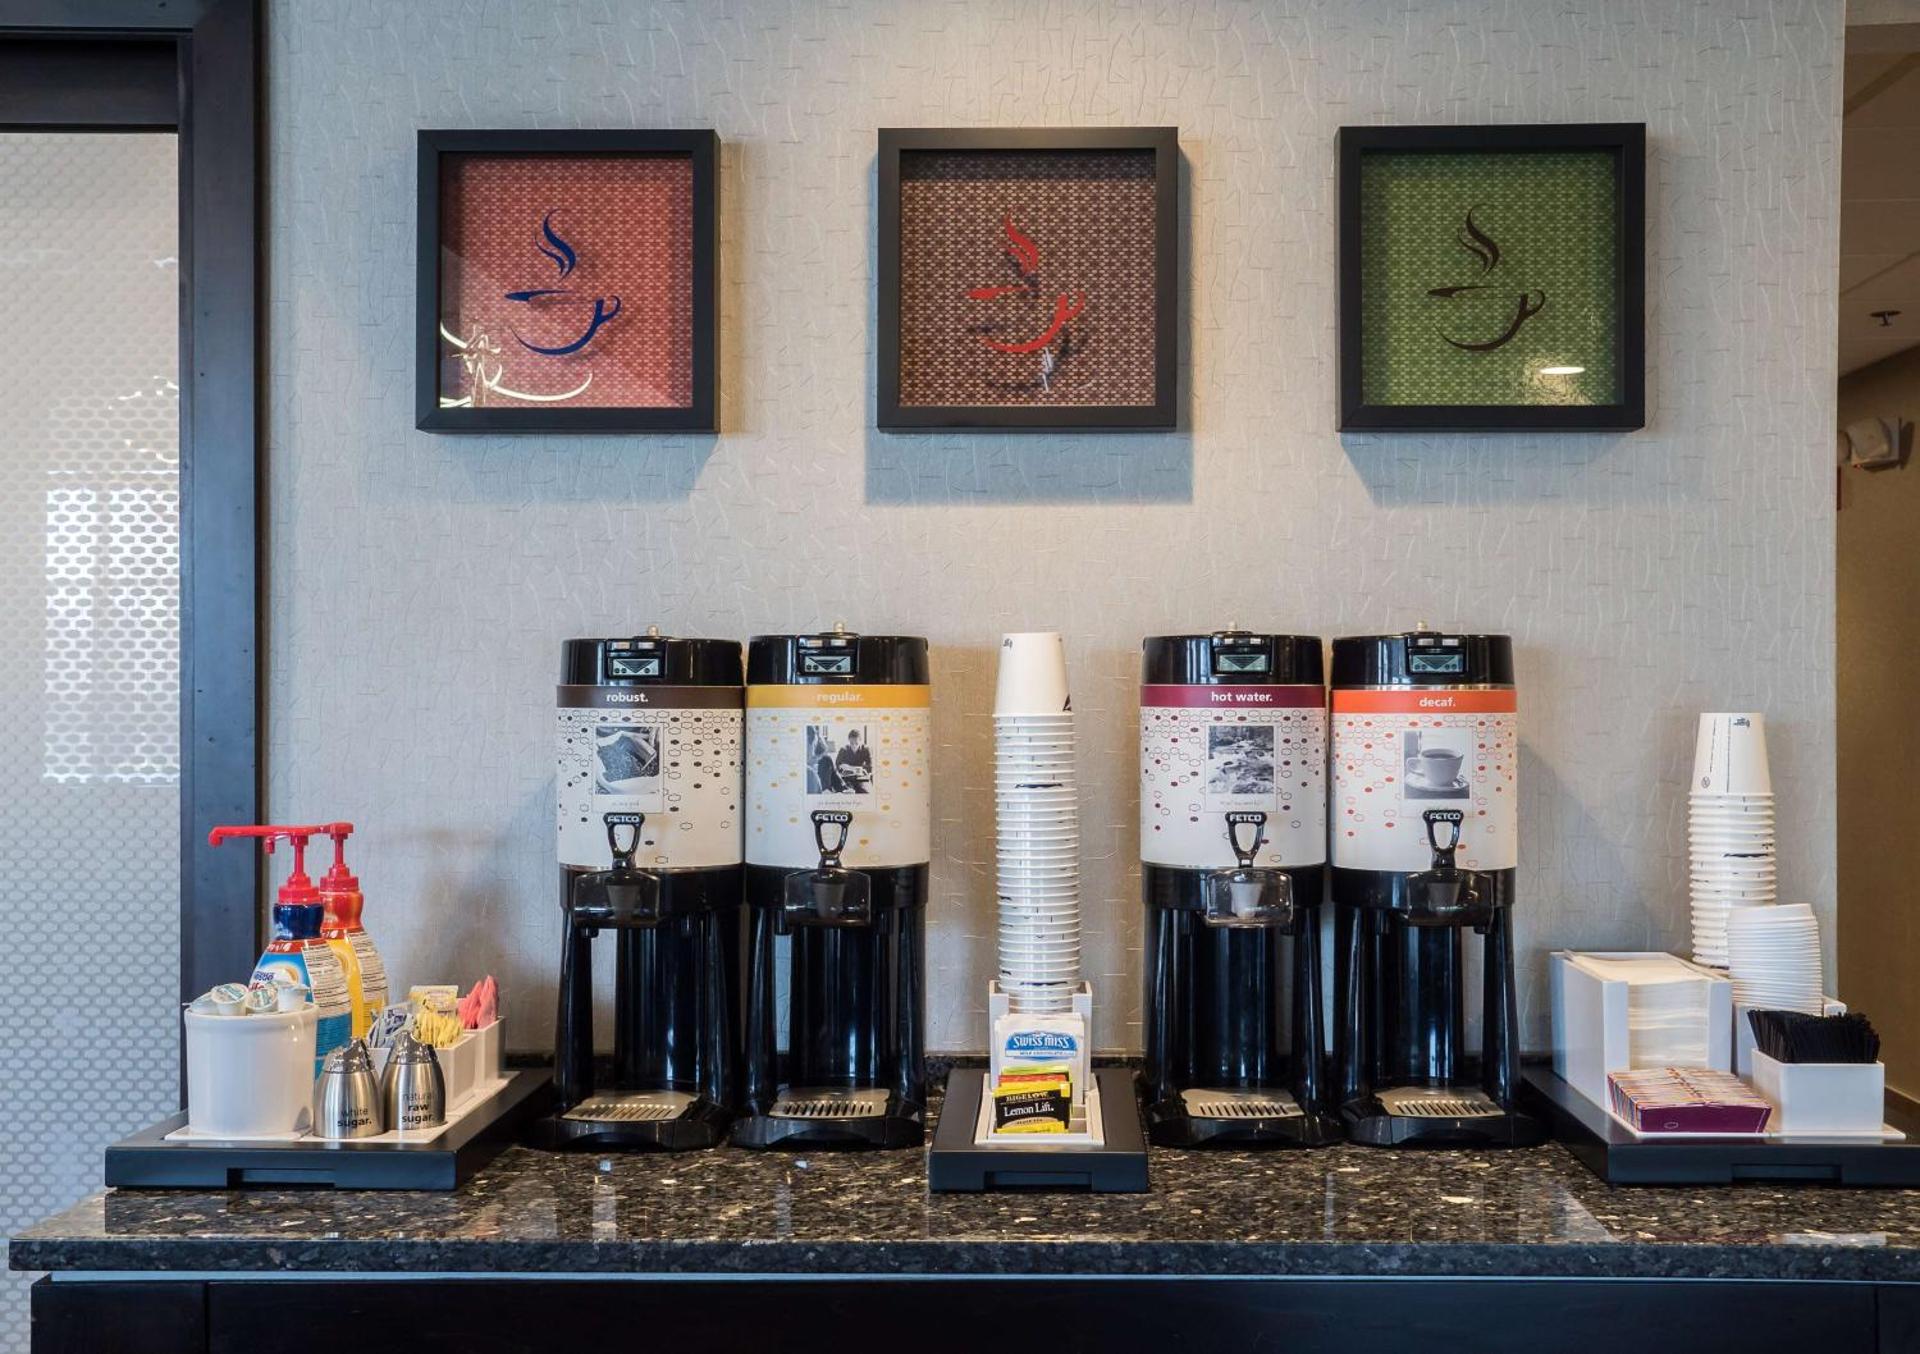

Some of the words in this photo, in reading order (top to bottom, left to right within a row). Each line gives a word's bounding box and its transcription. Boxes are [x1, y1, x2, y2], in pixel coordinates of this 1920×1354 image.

[606, 692, 649, 702] robust.
[816, 692, 864, 704] regular.
[1211, 691, 1232, 702] hot
[1235, 692, 1273, 702] water.
[1419, 697, 1456, 707] decaf.
[1429, 812, 1461, 820] FETCO
[403, 1091, 434, 1102] natura
[341, 1107, 369, 1118] white
[407, 1103, 430, 1112] raw
[1003, 1106, 1034, 1117] Lemon
[337, 1118, 372, 1129] sugar.
